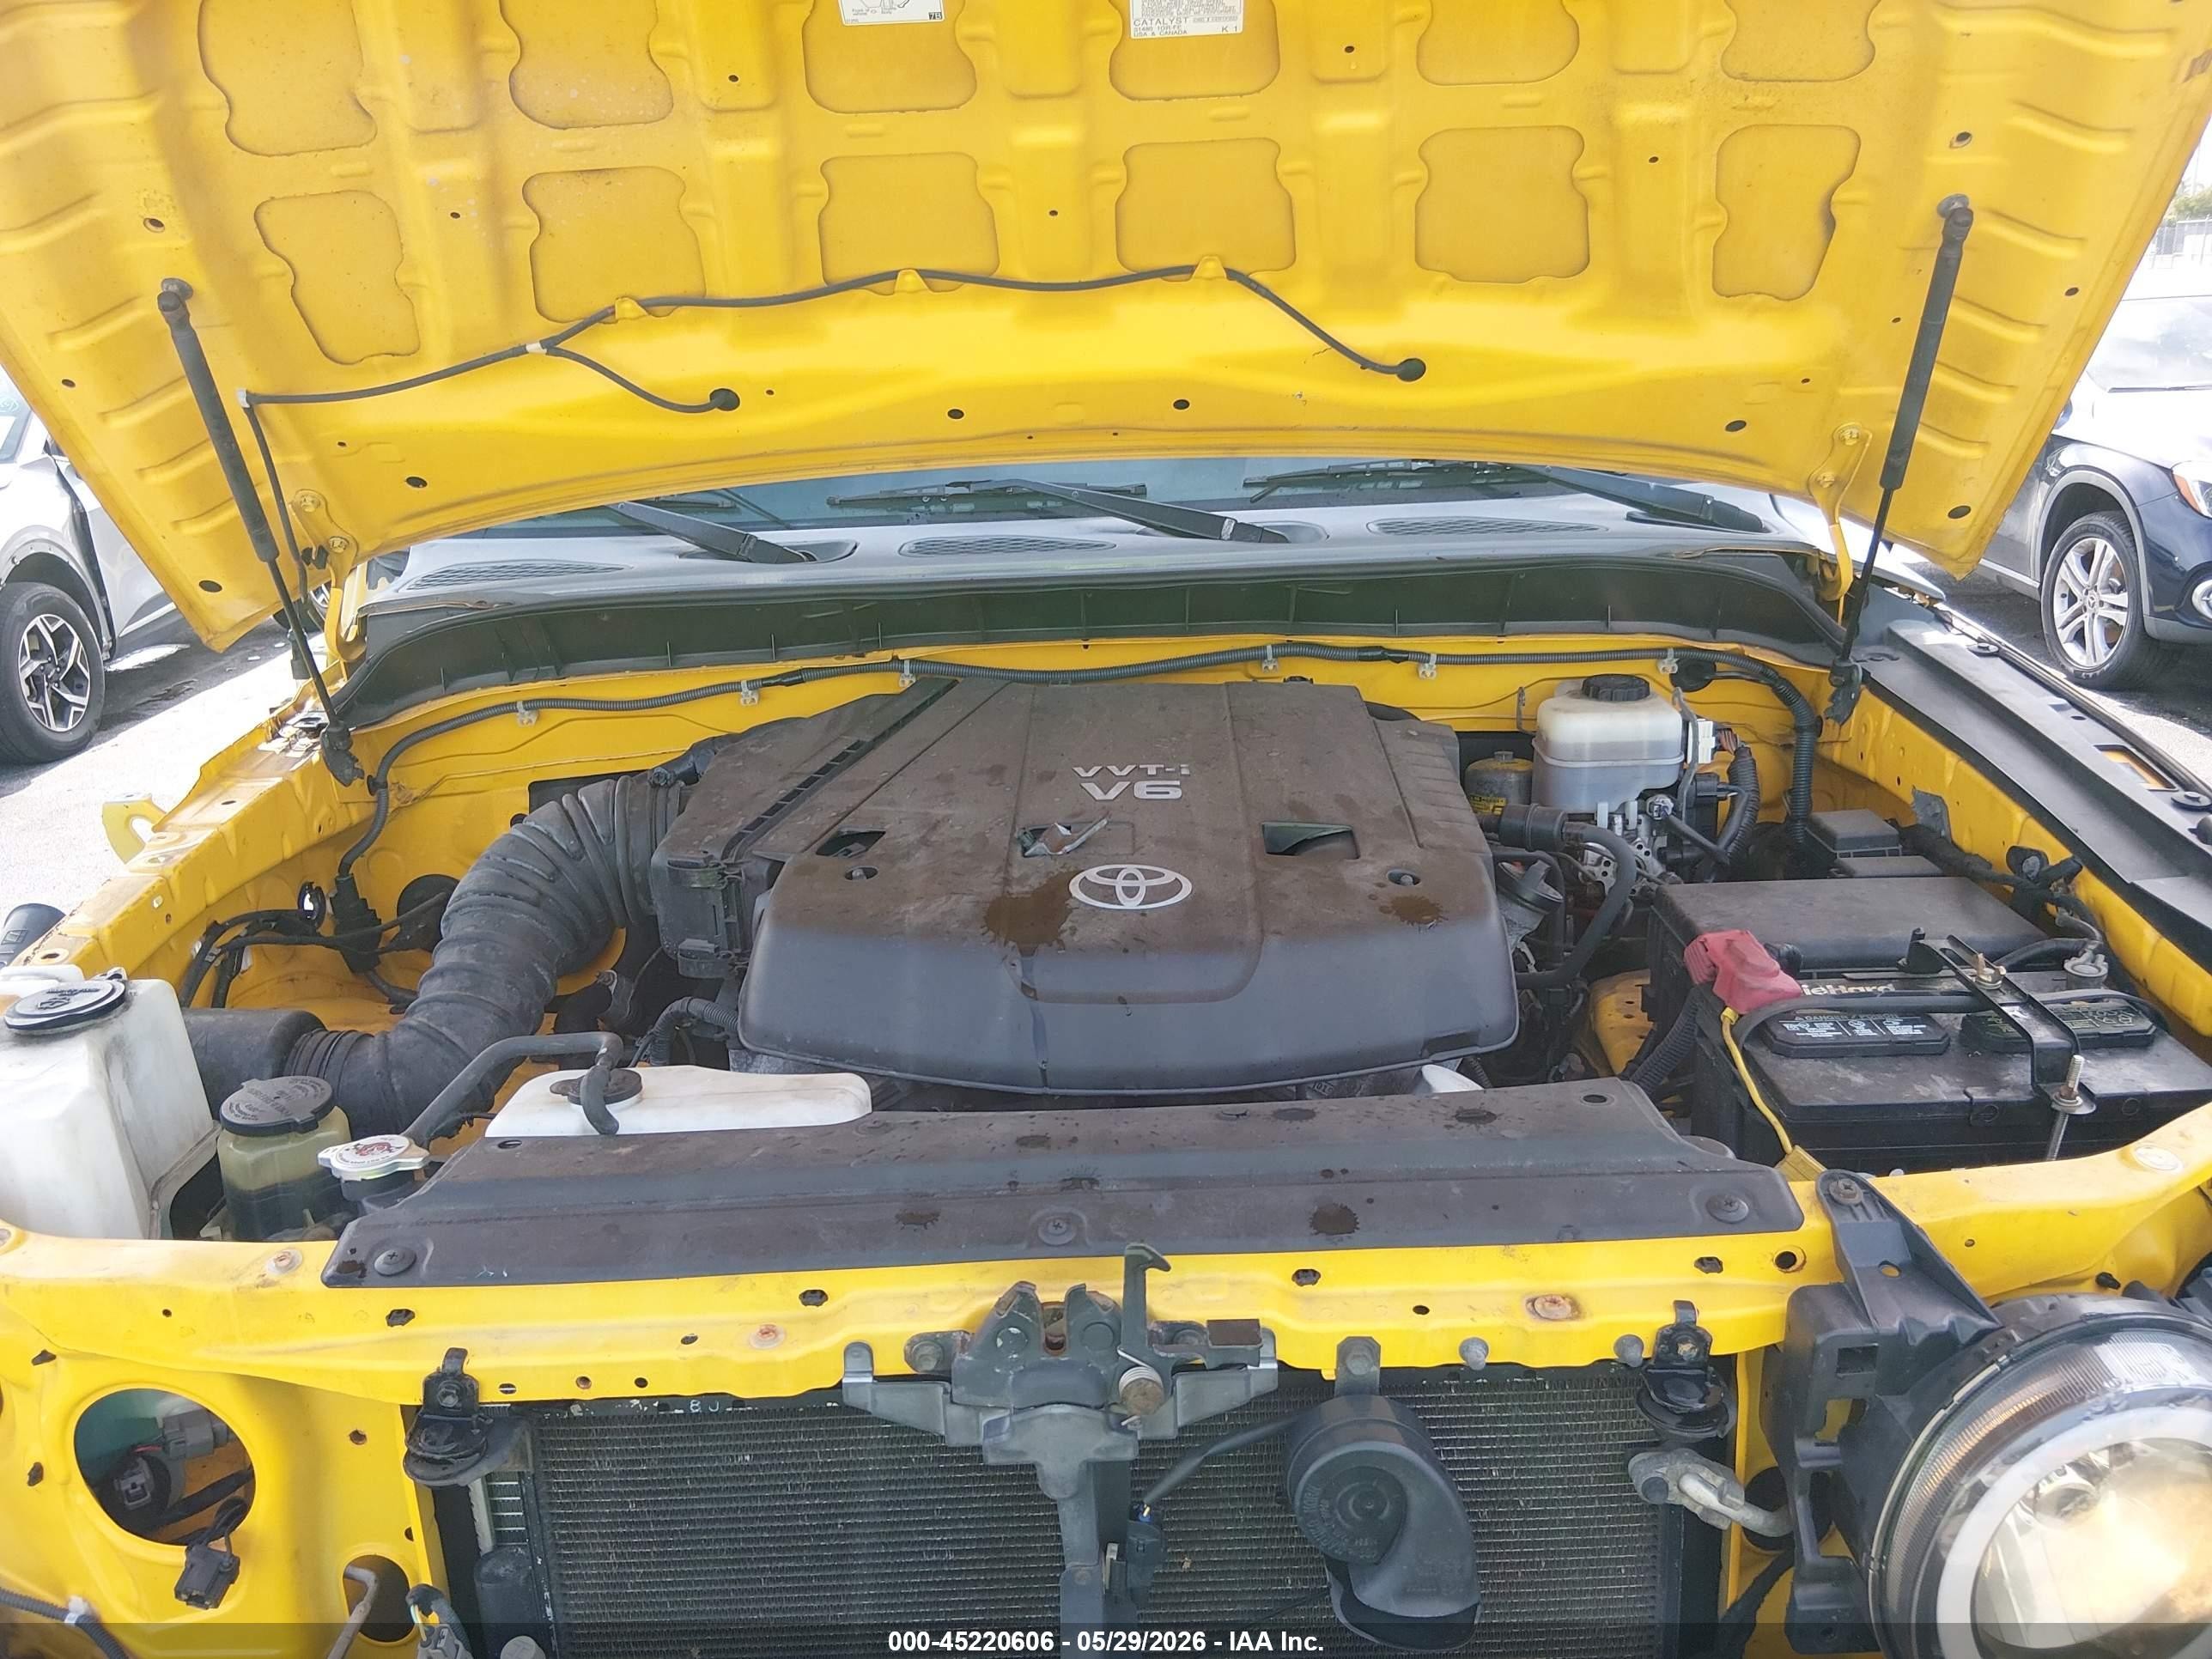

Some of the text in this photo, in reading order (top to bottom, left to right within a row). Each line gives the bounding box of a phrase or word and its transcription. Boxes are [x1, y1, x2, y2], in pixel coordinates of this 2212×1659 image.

[1133, 17, 1189, 27] CATALYST
[1072, 763, 1190, 777] VVT-i
[1080, 781, 1182, 800] V6
[1800, 983, 1896, 996] ieHard
